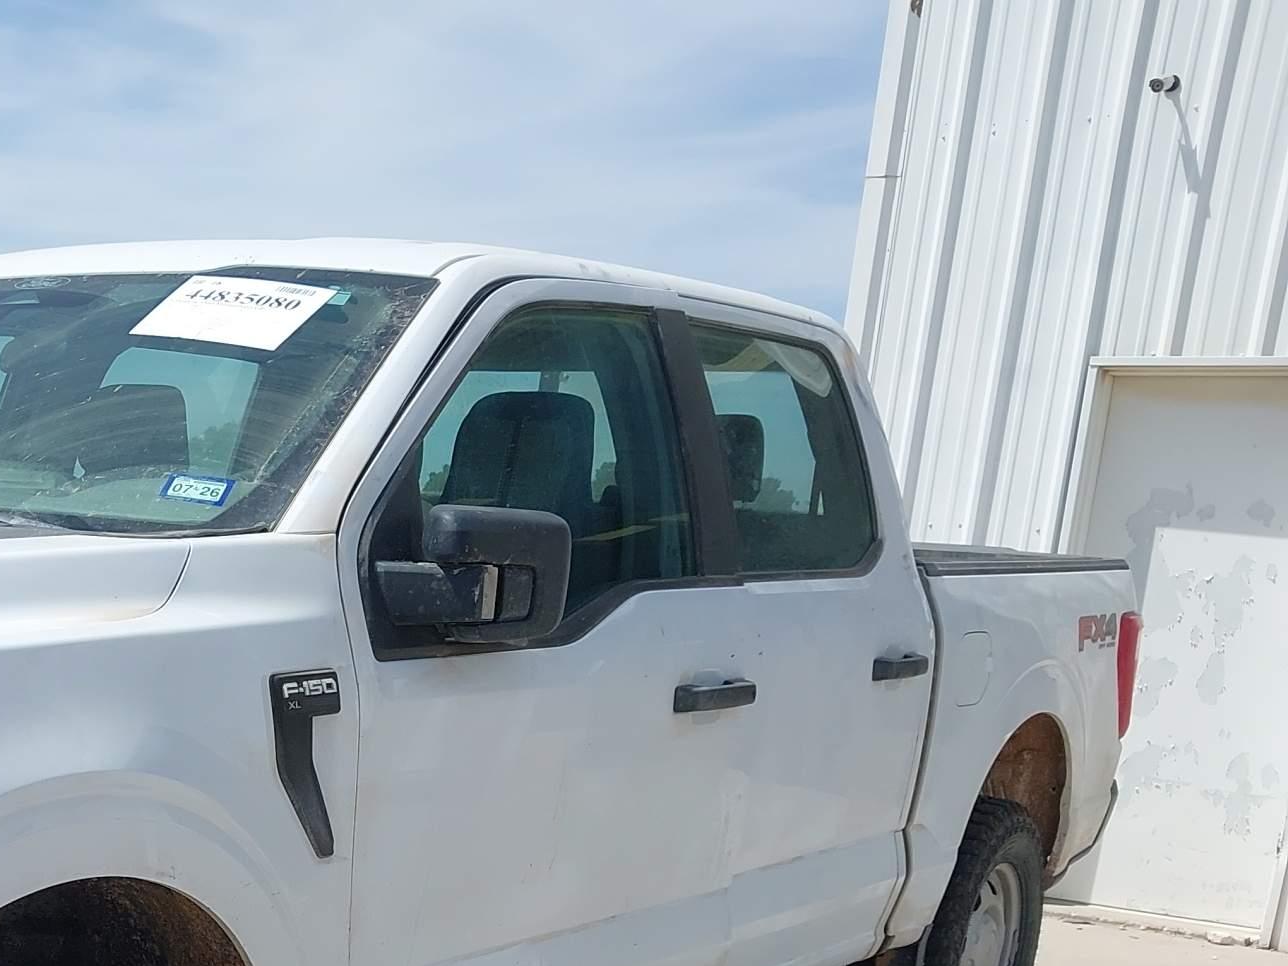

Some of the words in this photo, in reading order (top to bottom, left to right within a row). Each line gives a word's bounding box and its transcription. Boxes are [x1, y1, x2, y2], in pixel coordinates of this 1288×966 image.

[185, 287, 302, 312] 44835080
[172, 483, 194, 494] 07
[199, 486, 221, 497] 26
[1078, 612, 1117, 652] FX4
[282, 678, 338, 698] F-150
[288, 701, 302, 710] XL
